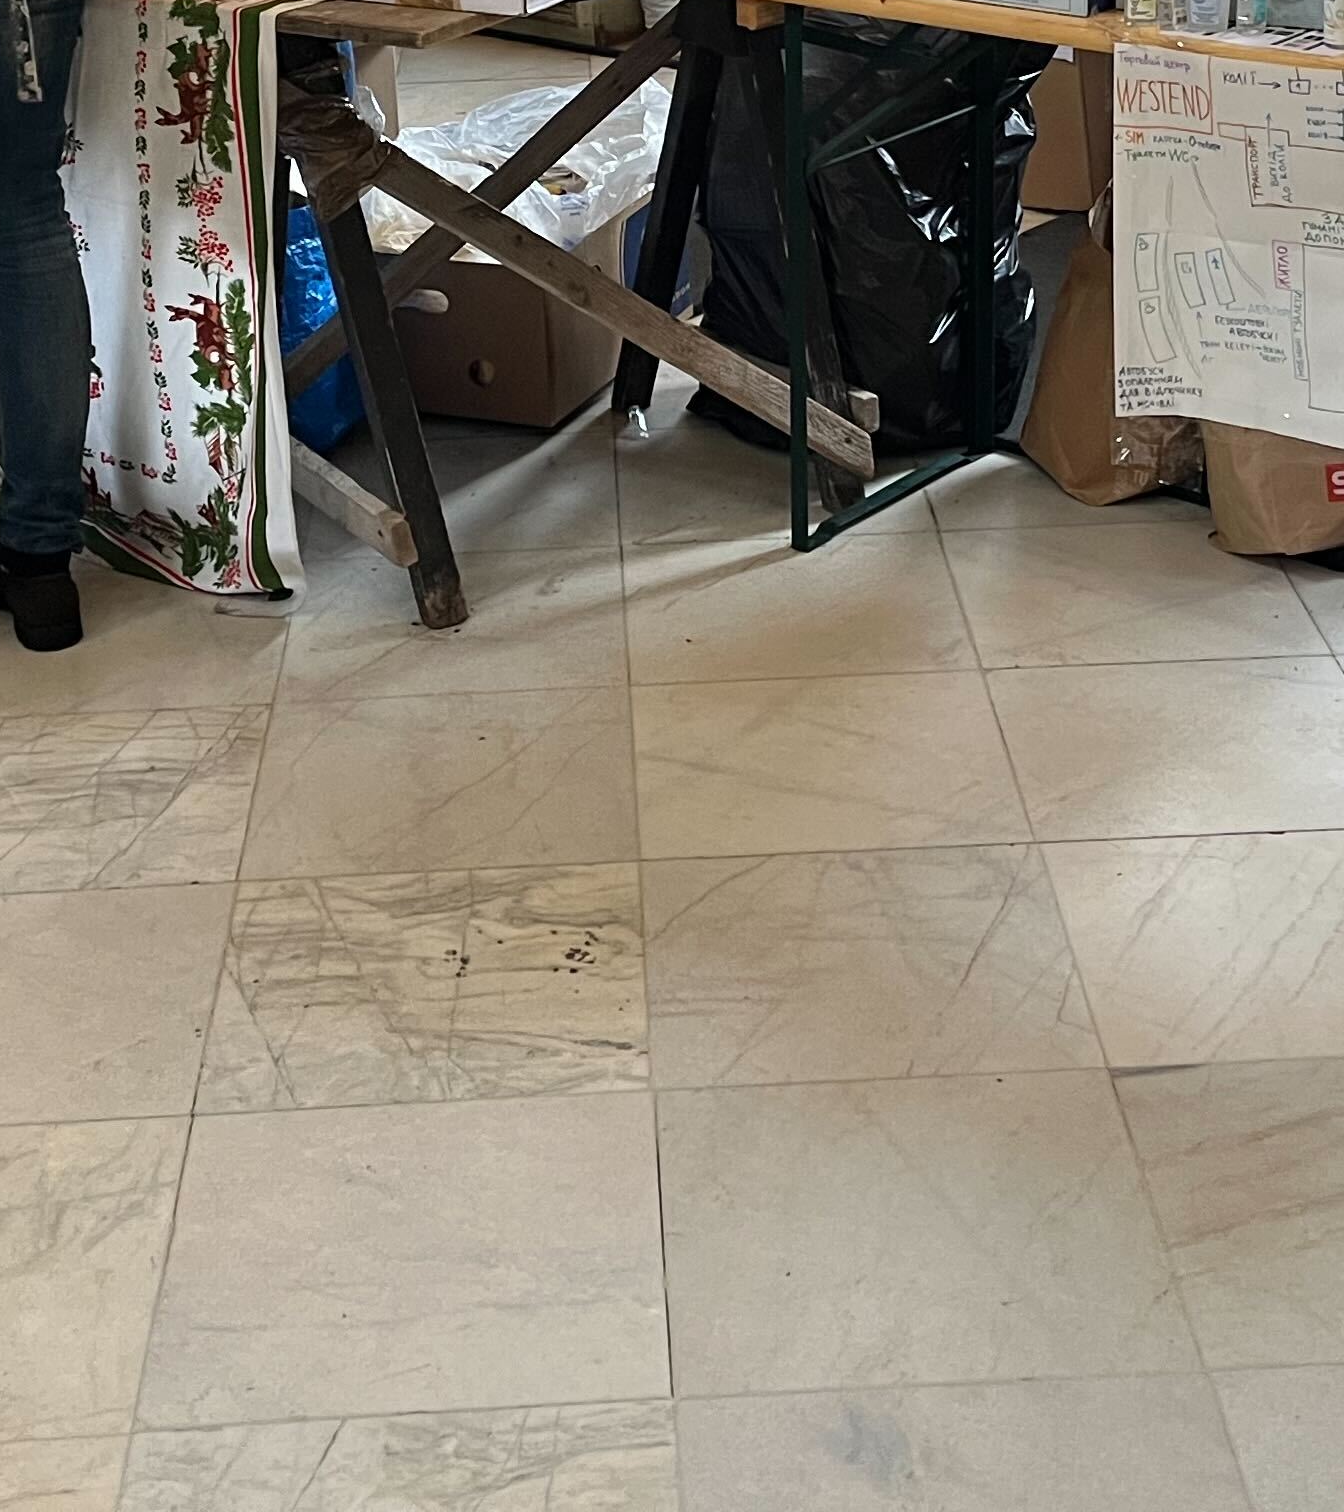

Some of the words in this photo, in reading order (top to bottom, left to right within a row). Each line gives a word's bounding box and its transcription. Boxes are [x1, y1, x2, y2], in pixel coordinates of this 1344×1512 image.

[1117, 76, 1210, 121] WESTEND
[1126, 131, 1145, 145] SIM
[1276, 245, 1292, 288] ЖИТЛО
